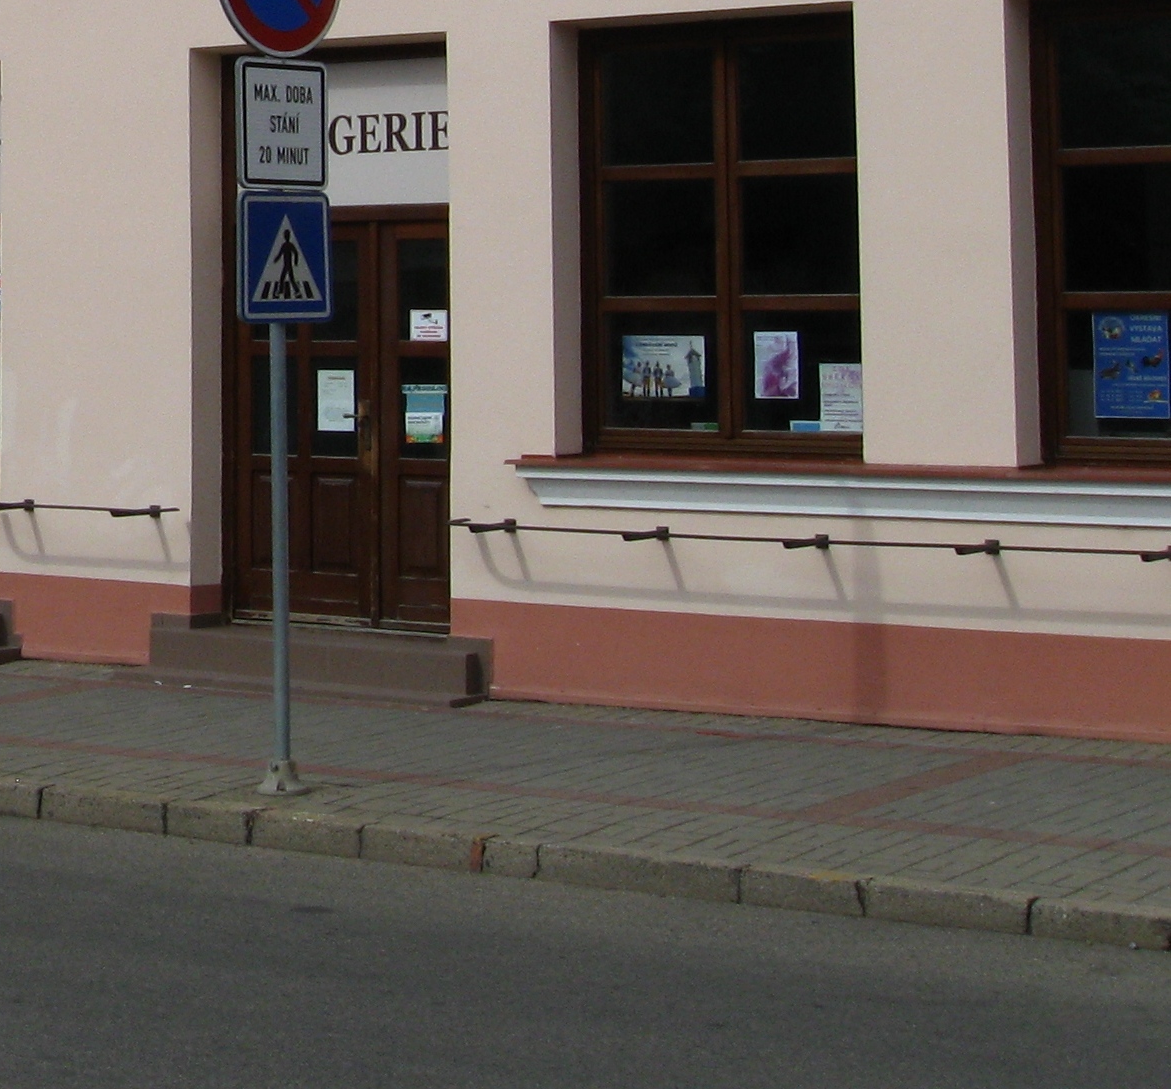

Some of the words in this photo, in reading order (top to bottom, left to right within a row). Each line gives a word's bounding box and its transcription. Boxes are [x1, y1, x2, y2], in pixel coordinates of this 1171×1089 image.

[254, 83, 281, 102] MAX.
[286, 85, 313, 104] DOBA
[270, 112, 300, 133] STÁNÍ
[328, 110, 449, 155] GERIE
[259, 145, 272, 164] 20
[277, 146, 310, 165] MINUT
